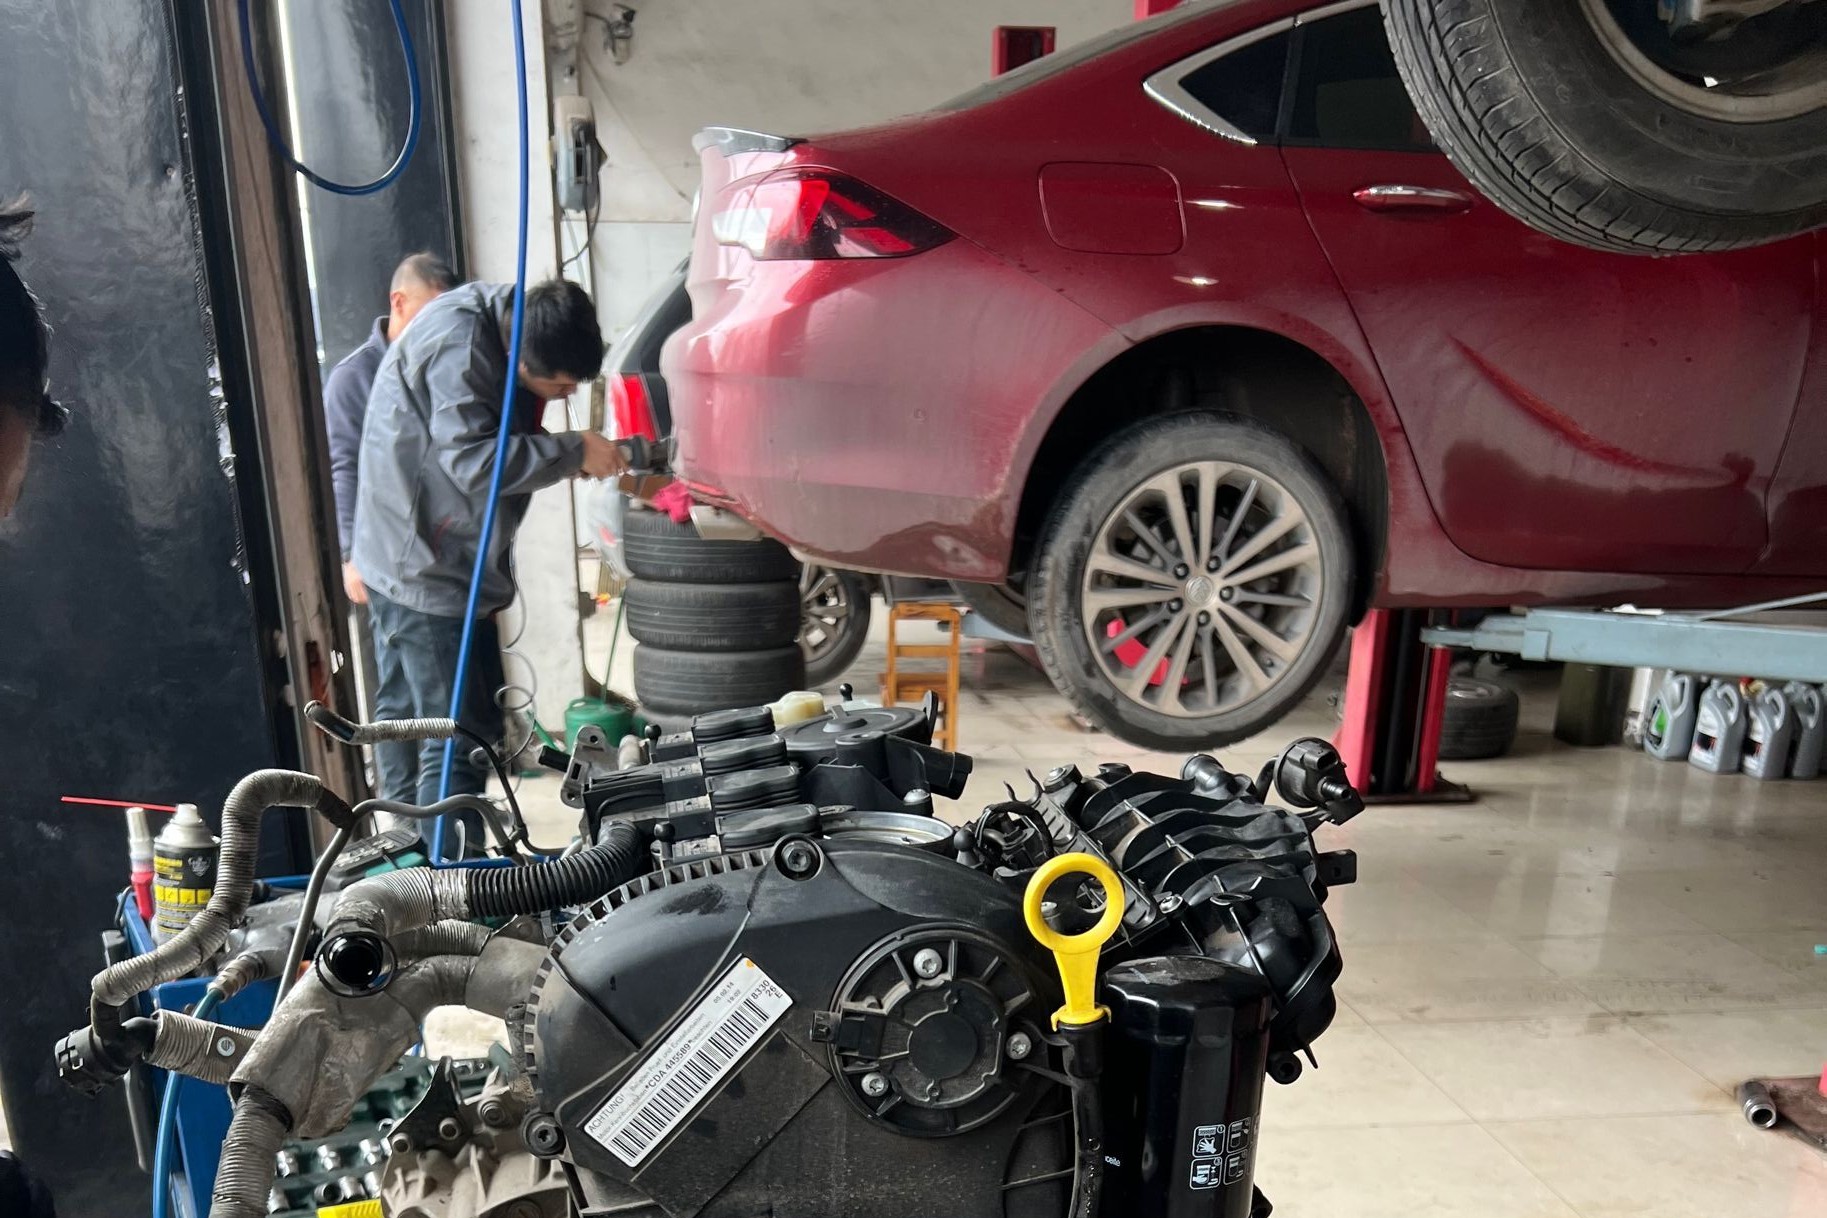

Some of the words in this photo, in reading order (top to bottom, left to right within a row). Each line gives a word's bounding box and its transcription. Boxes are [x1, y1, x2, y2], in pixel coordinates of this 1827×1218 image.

[751, 980, 770, 999] 8330
[766, 985, 777, 997] 26
[775, 990, 783, 999] E
[586, 1092, 627, 1133] ACHTUNG!
